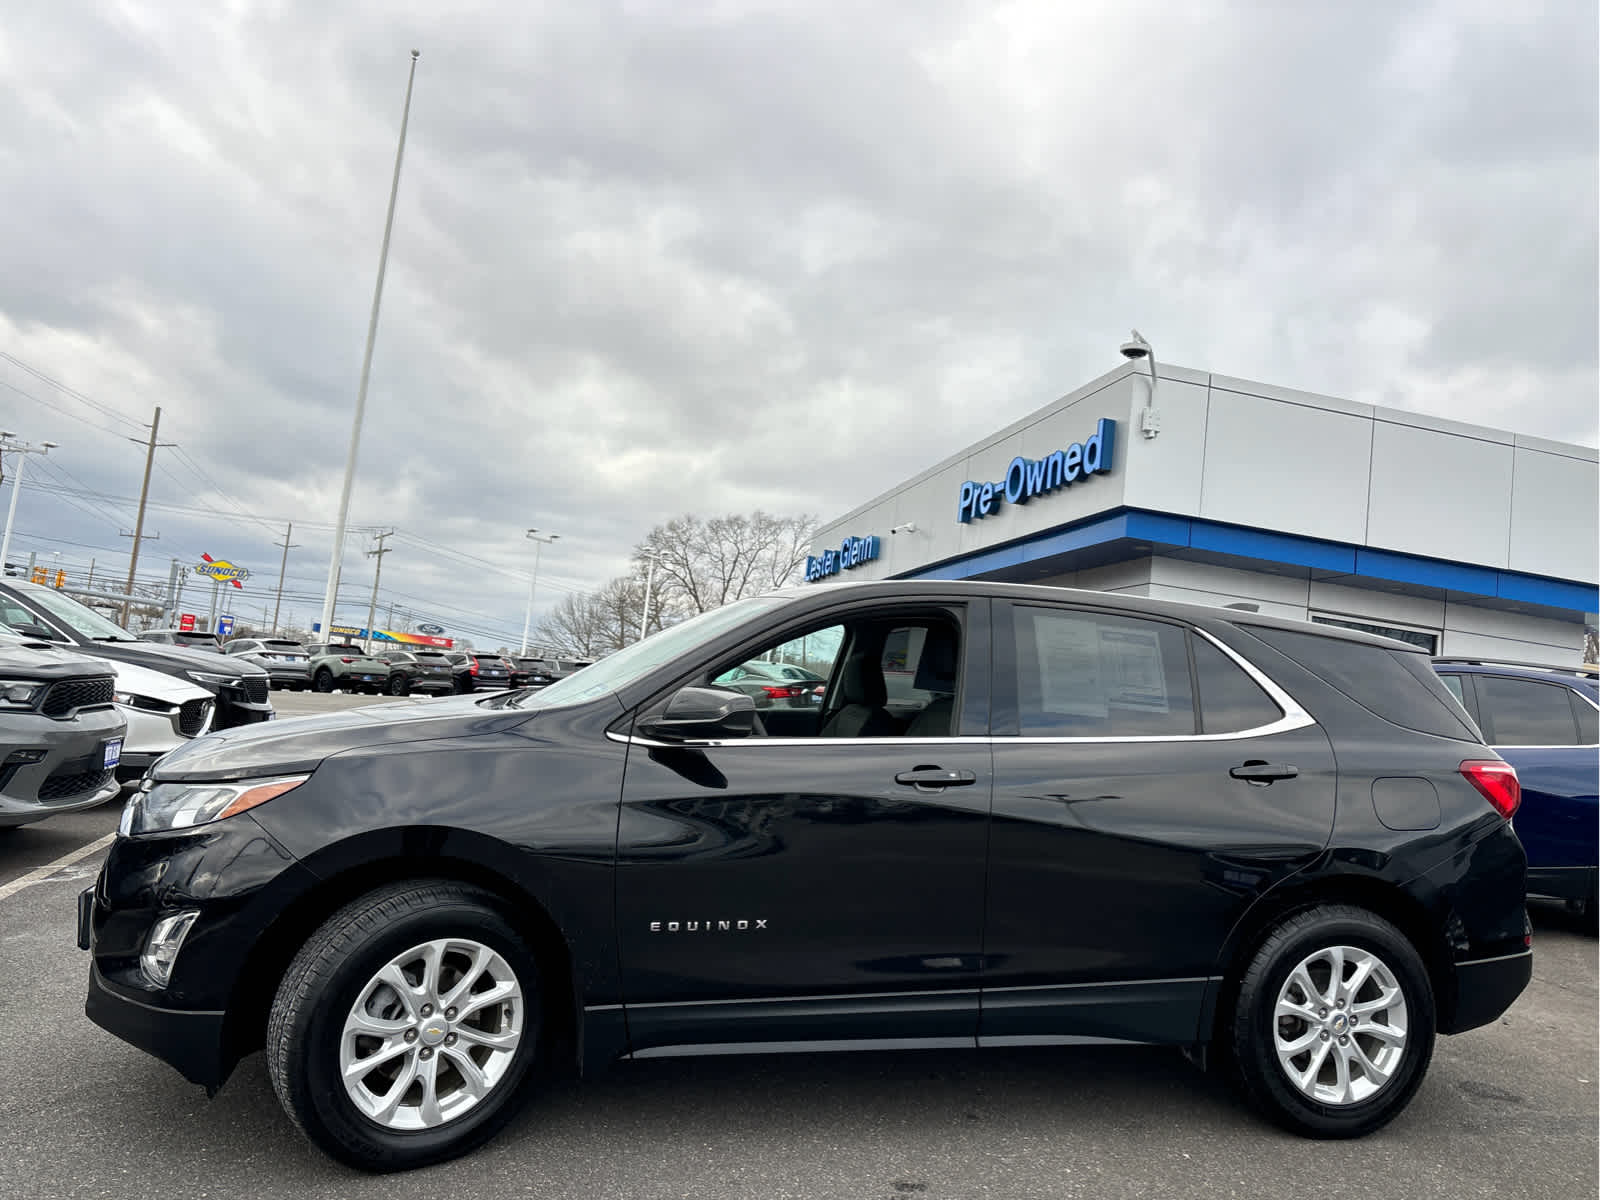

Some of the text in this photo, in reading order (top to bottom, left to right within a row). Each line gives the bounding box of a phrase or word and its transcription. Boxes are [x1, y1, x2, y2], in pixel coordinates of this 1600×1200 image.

[957, 417, 1116, 523] Pre-Owned
[199, 564, 245, 578] SUNOCO
[804, 535, 880, 582] Lester Glenn
[650, 919, 768, 932] EQUINOX
